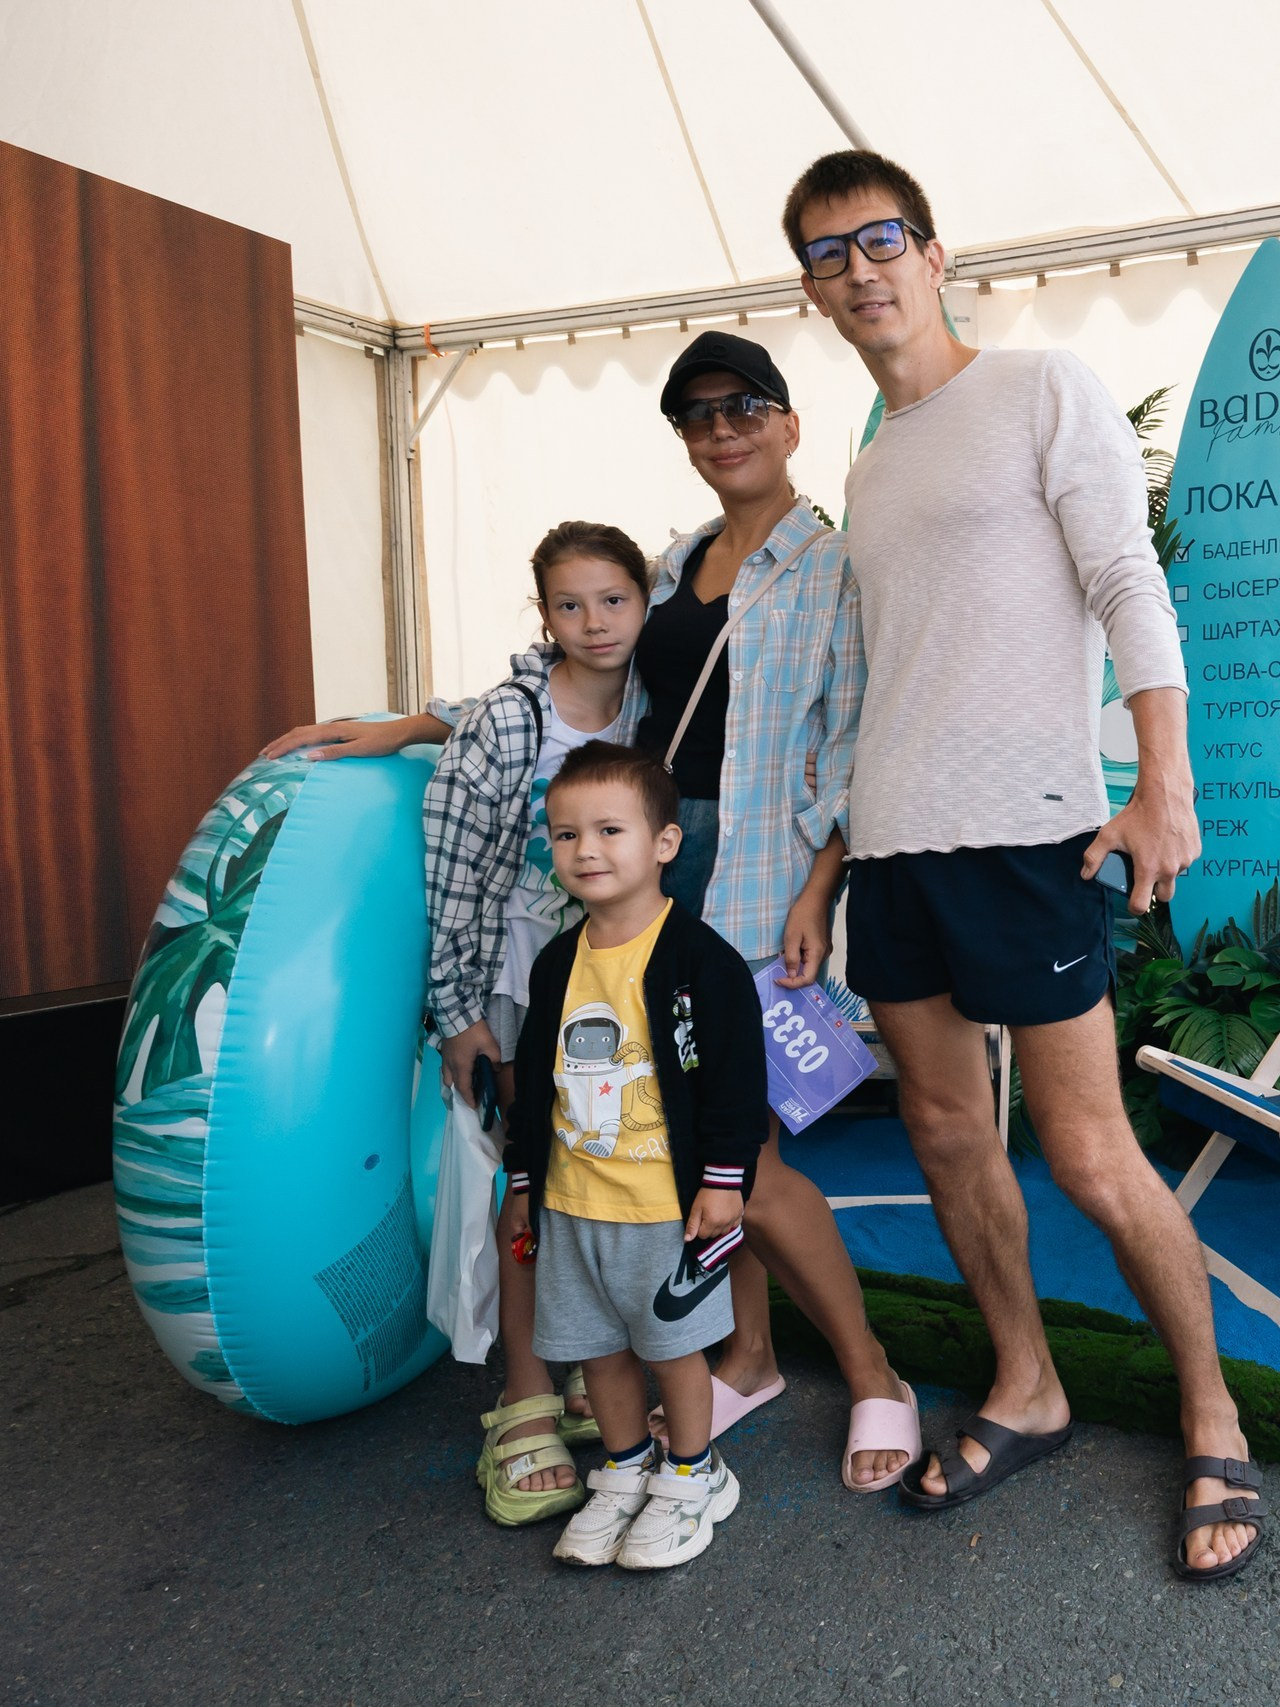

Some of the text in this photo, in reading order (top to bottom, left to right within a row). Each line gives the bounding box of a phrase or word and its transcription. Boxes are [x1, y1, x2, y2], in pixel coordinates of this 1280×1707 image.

[1203, 742, 1263, 760] УКТУС
[1202, 782, 1280, 801] ЕТКУЛЬ
[1202, 819, 1249, 837] РЕЖ
[1202, 859, 1280, 877] КУРГАН
[762, 1000, 829, 1074] 0333
